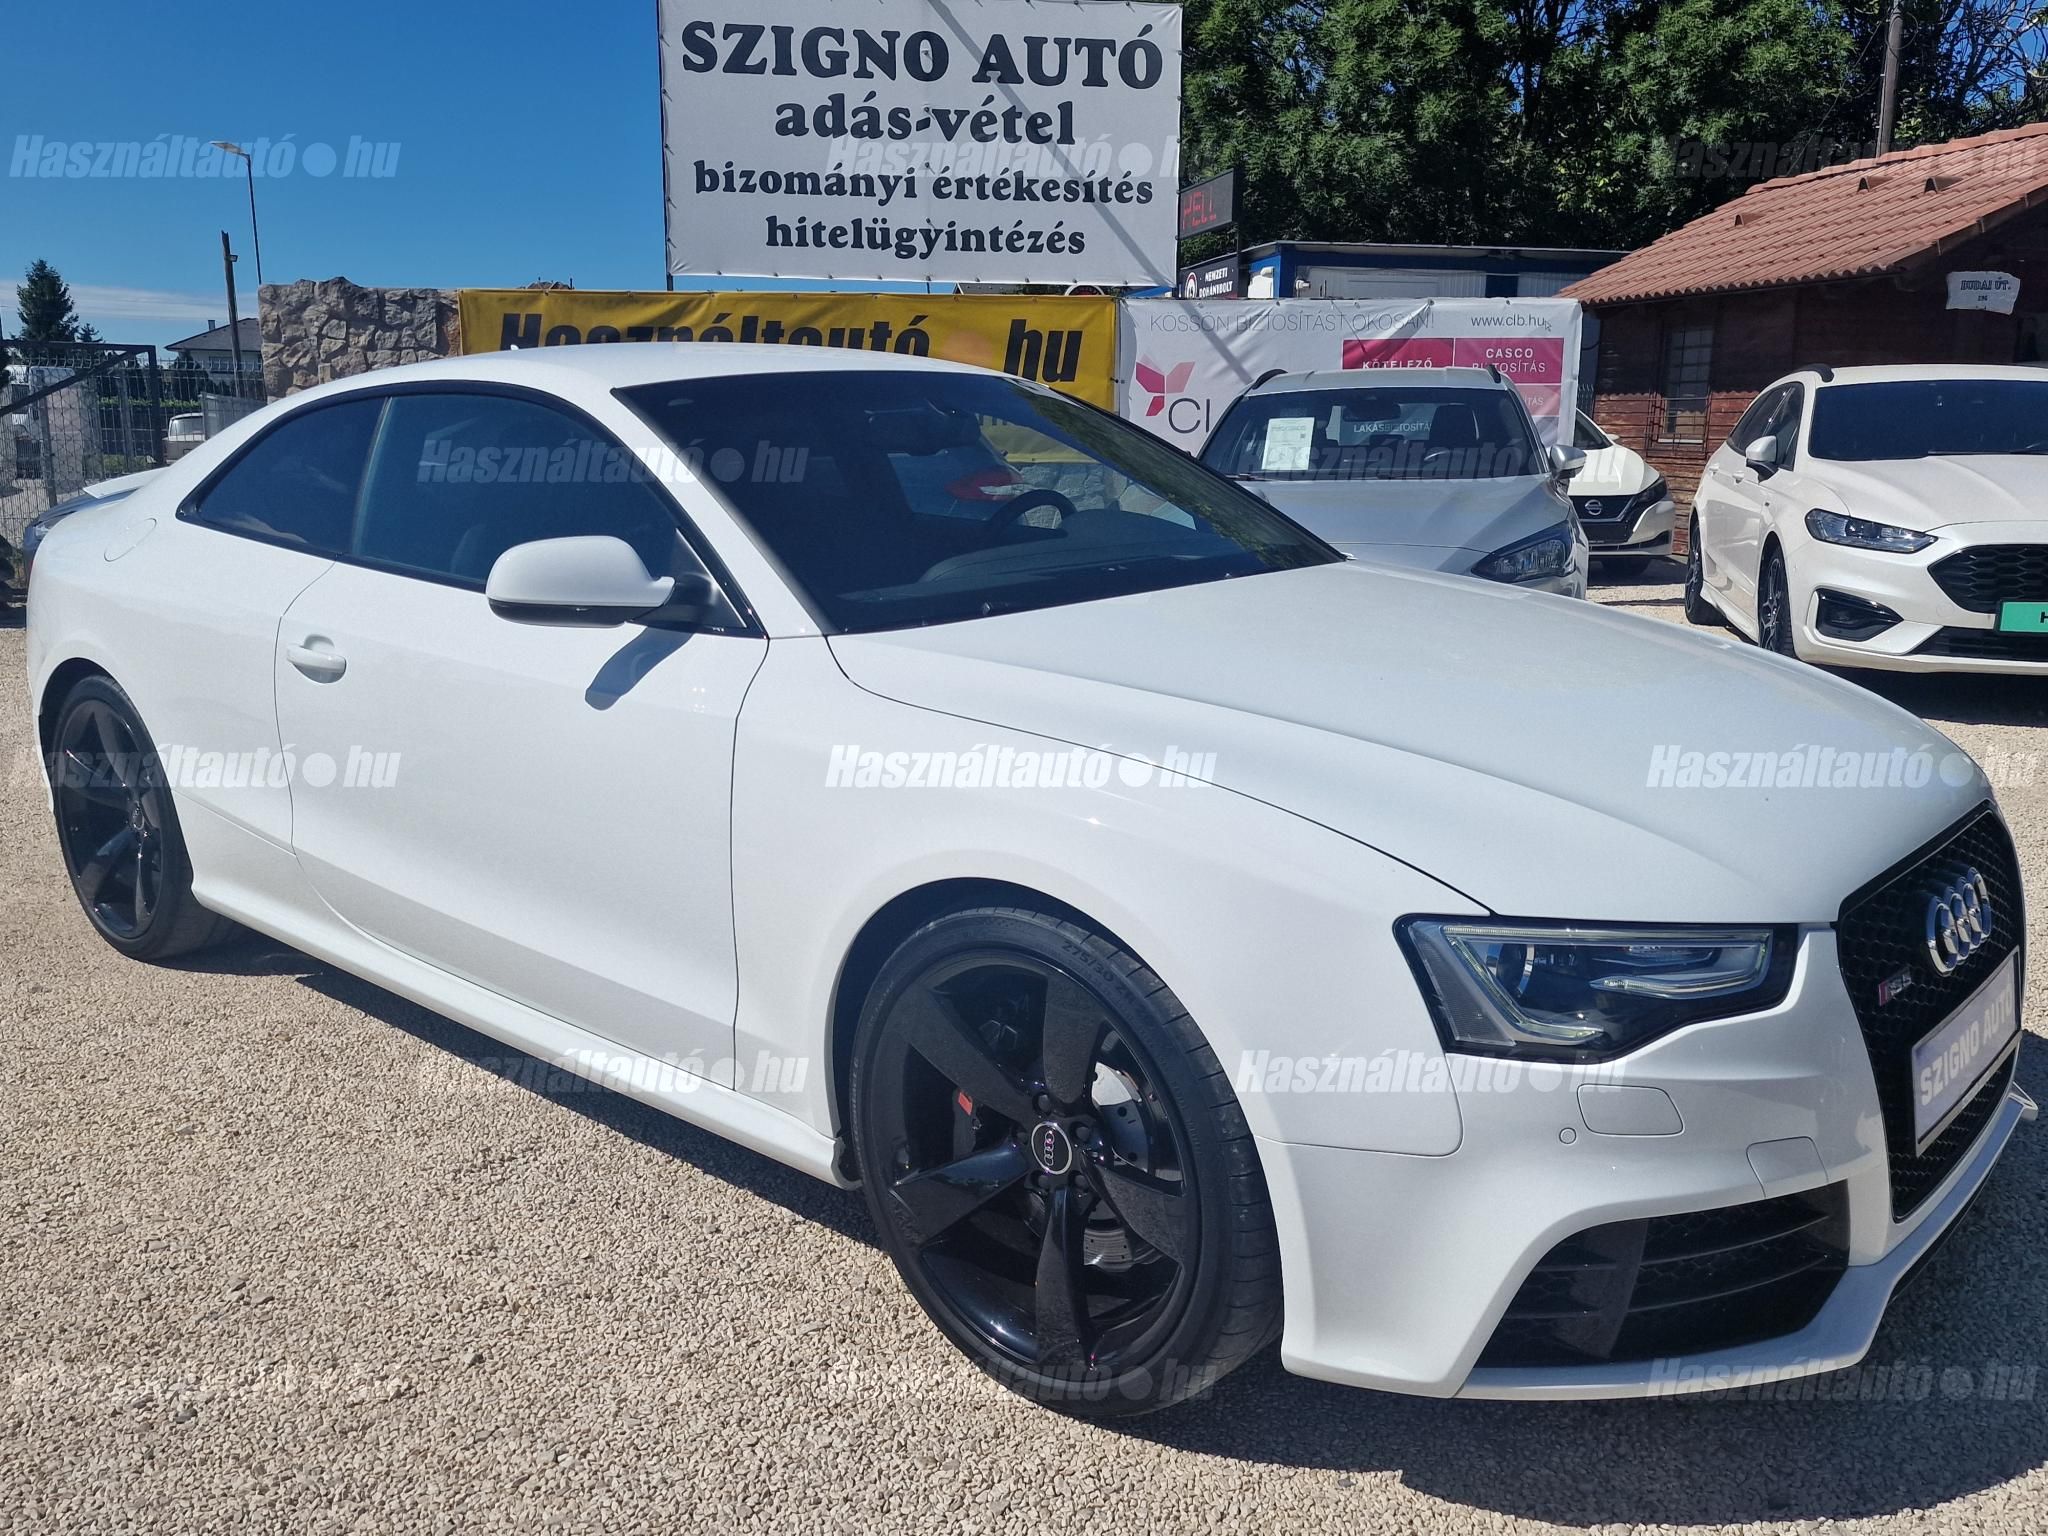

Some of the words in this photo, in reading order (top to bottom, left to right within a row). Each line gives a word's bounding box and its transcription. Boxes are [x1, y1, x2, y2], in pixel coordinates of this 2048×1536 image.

[681, 20, 950, 83] SZIGNO
[971, 23, 1164, 90] AUTÓ
[775, 91, 1075, 146] adás-vétel
[693, 160, 918, 206] bizományi
[931, 164, 1154, 205] értékesítés
[765, 215, 1086, 260] hitelügyintézés
[1204, 267, 1228, 282] NEMZETI
[1150, 311, 1230, 332] KÖSSÖN
[1236, 310, 1346, 332] BIZTOSÍTÁST
[1352, 311, 1435, 332] OKOSAN!
[1470, 313, 1546, 328] www.clb.hu
[1472, 359, 1546, 374] BITOSÍTÁS
[1485, 348, 1535, 359] CASCO
[1920, 1020, 1980, 1106] SZIGNO
